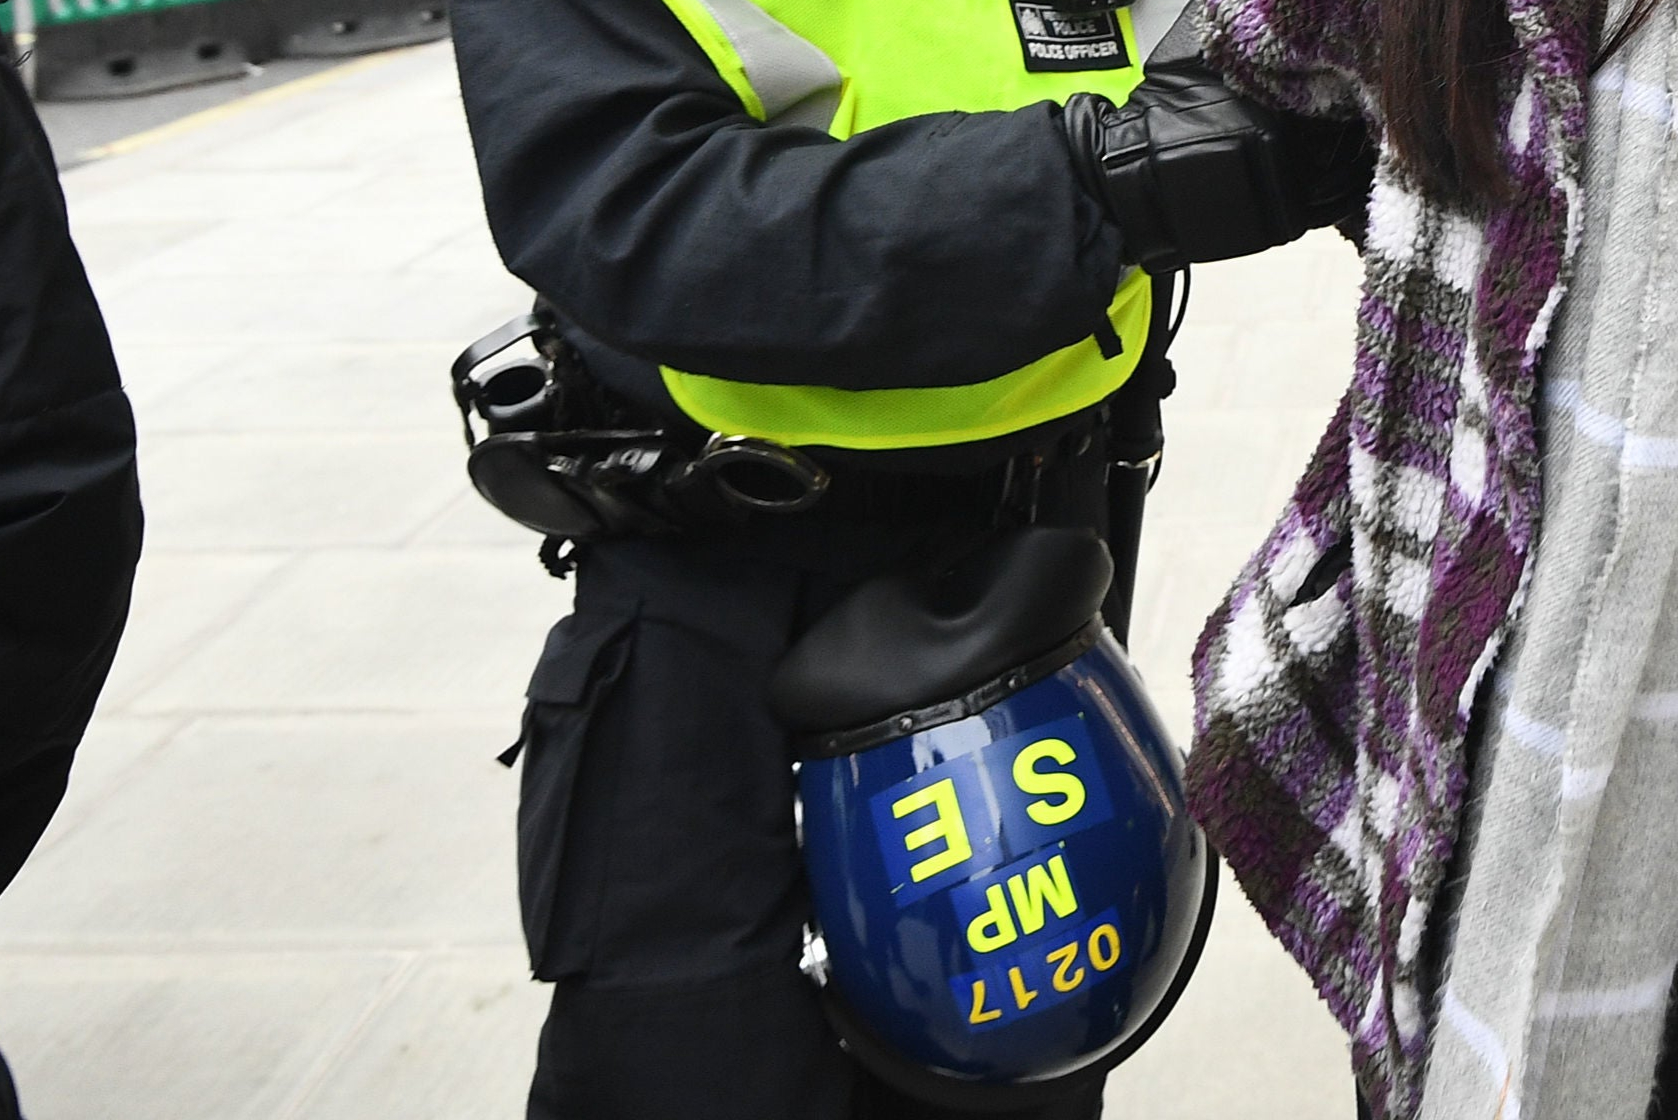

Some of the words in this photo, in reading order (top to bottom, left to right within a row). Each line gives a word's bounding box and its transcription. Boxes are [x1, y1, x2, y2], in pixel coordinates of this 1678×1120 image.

[1027, 42, 1065, 60] POLICE
[1064, 40, 1119, 60] OFFICER
[966, 854, 1079, 954] MP
[968, 923, 1121, 1025] 0217
